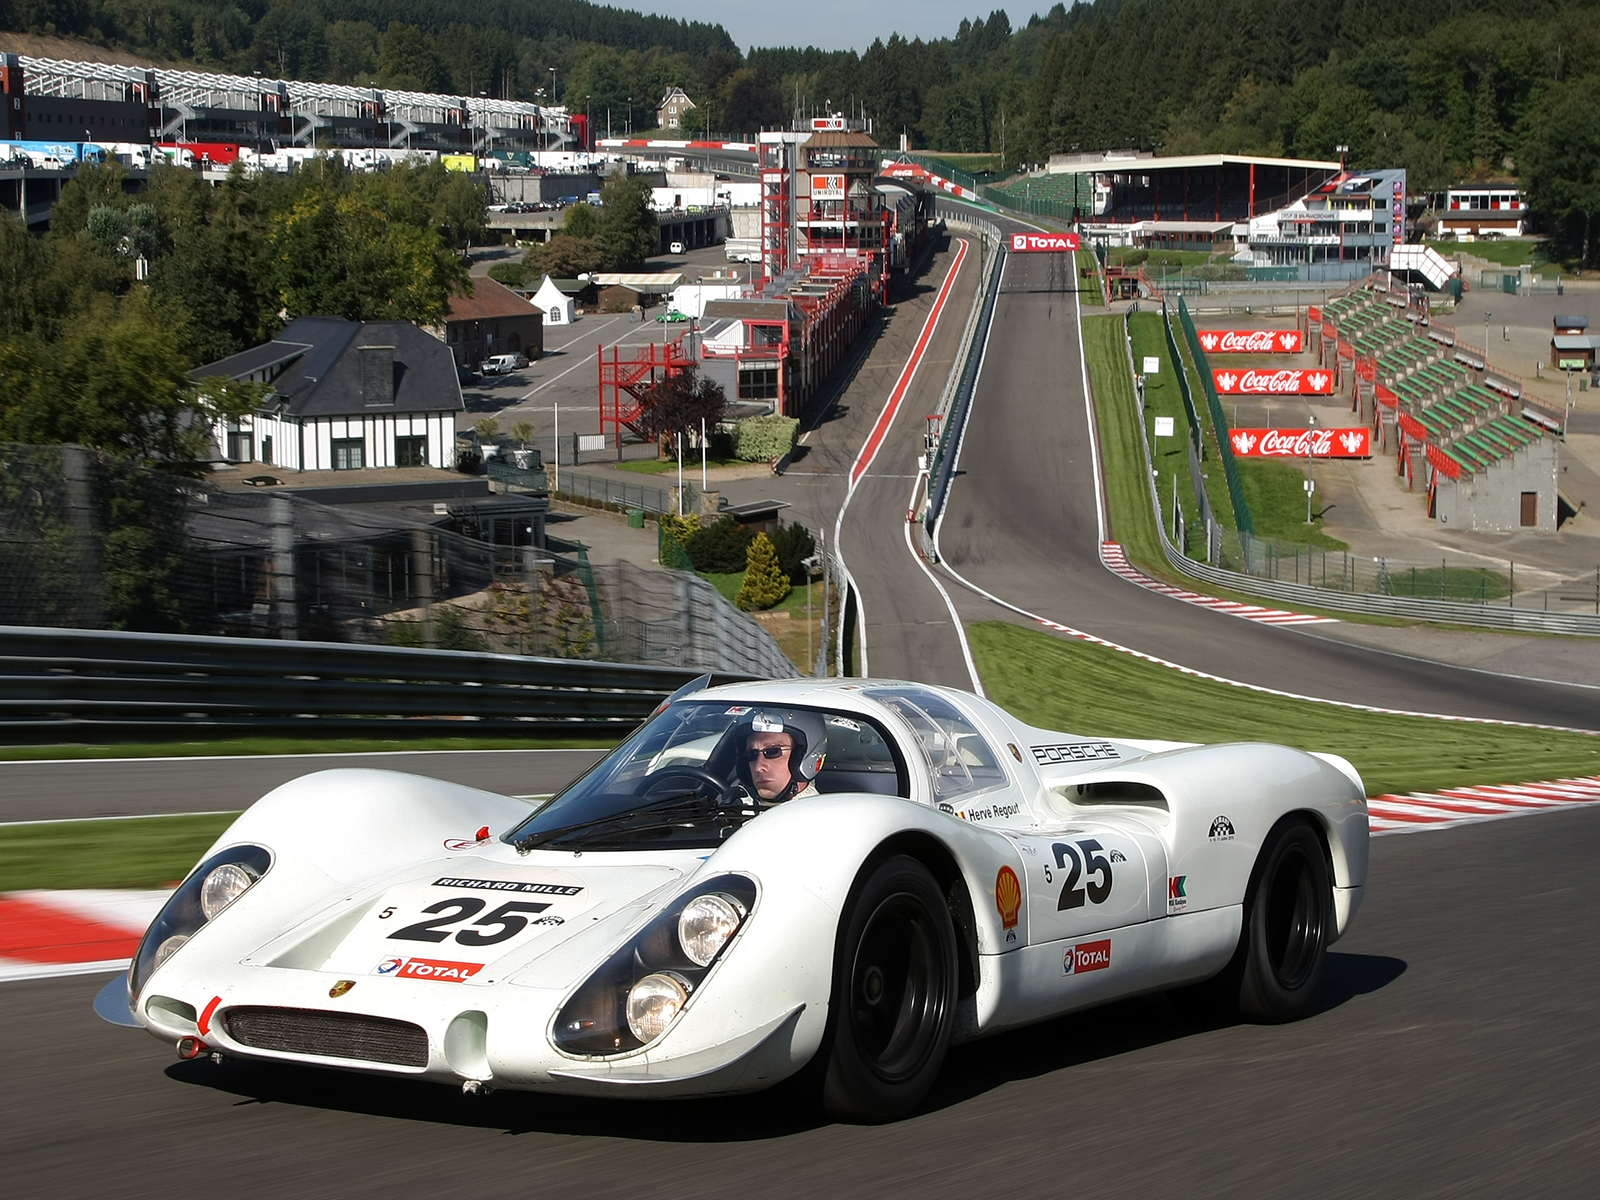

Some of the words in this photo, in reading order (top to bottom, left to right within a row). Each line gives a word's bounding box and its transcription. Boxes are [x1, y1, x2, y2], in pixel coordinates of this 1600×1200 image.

[1028, 237, 1076, 248] TOTAL
[1220, 331, 1276, 351] Coca-Cola
[1239, 370, 1304, 393] Coca-Cola
[1259, 430, 1335, 455] Coca-Cola
[1031, 744, 1119, 763] PORSCHE
[993, 802, 1021, 819] Regout
[1044, 864, 1053, 884] 5
[1052, 839, 1113, 911] 25
[438, 877, 516, 891] RICHARD
[520, 885, 579, 895] MILLE
[378, 906, 398, 919] 5
[386, 897, 553, 946] 25
[1076, 949, 1109, 966] TOTAL
[407, 962, 472, 980] TOTAL
